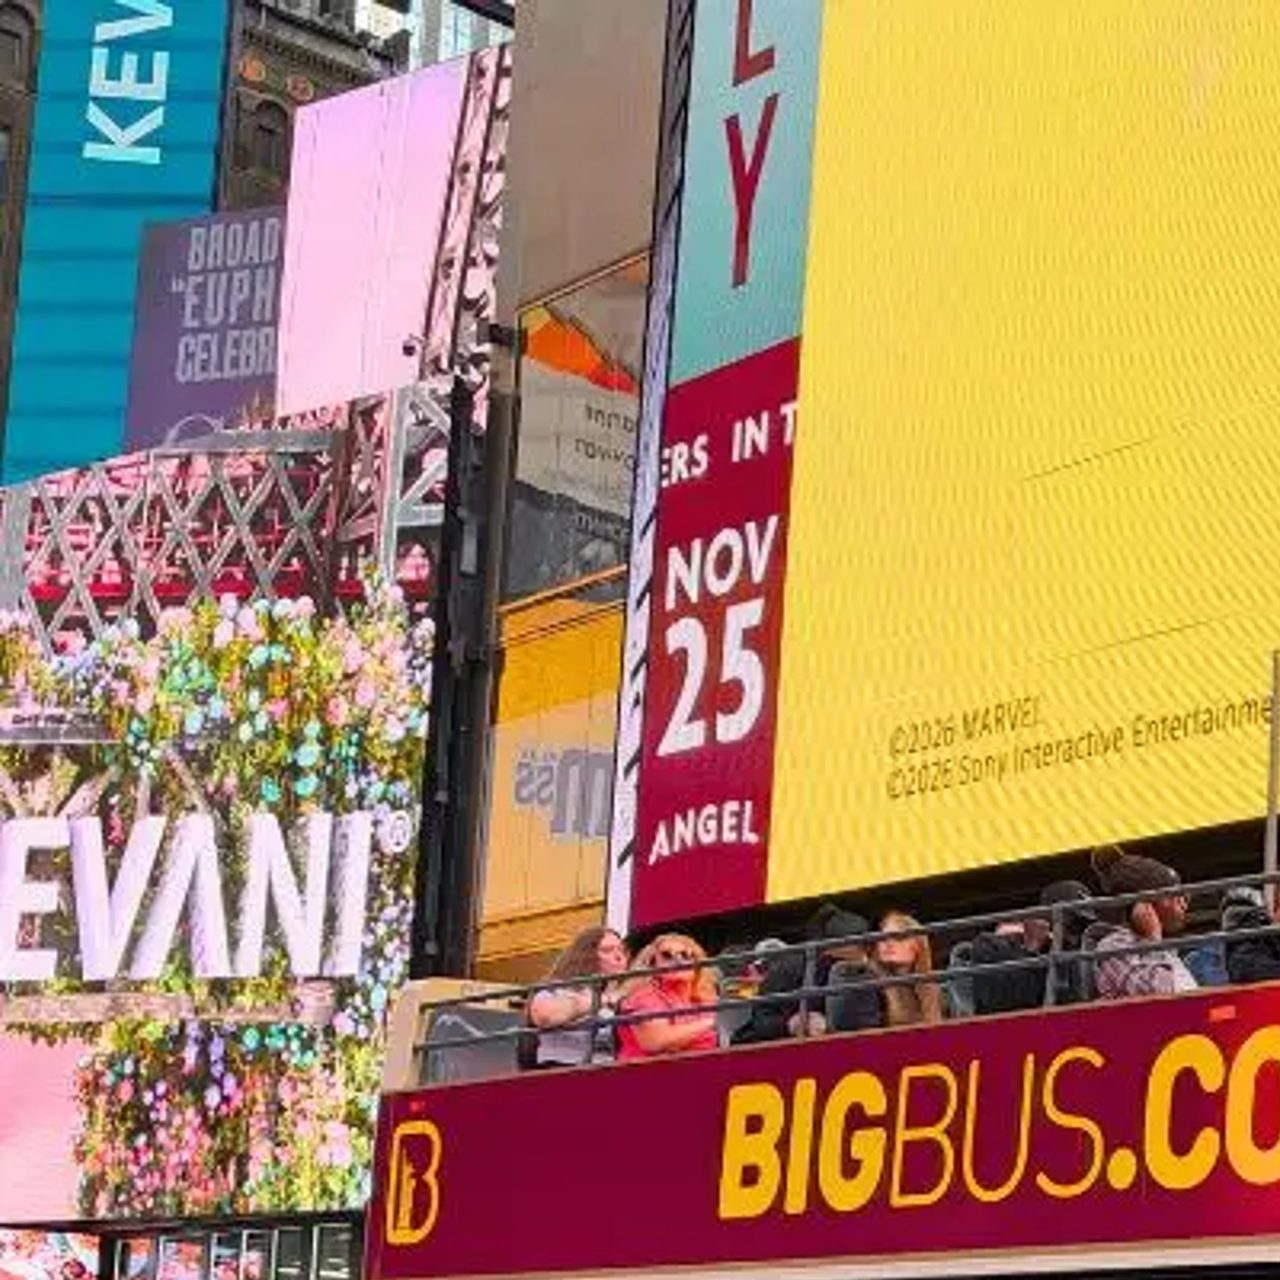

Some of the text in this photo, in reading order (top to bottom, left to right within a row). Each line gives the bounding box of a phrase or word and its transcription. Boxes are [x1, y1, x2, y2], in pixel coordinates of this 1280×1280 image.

[732, 410, 768, 462] IN
[664, 515, 778, 609] NOV
[657, 597, 766, 757] 25
[963, 697, 1039, 741] MARVEL
[959, 752, 1009, 784] Sony
[1014, 723, 1125, 775] Interactive
[648, 799, 758, 865] ANGEL
